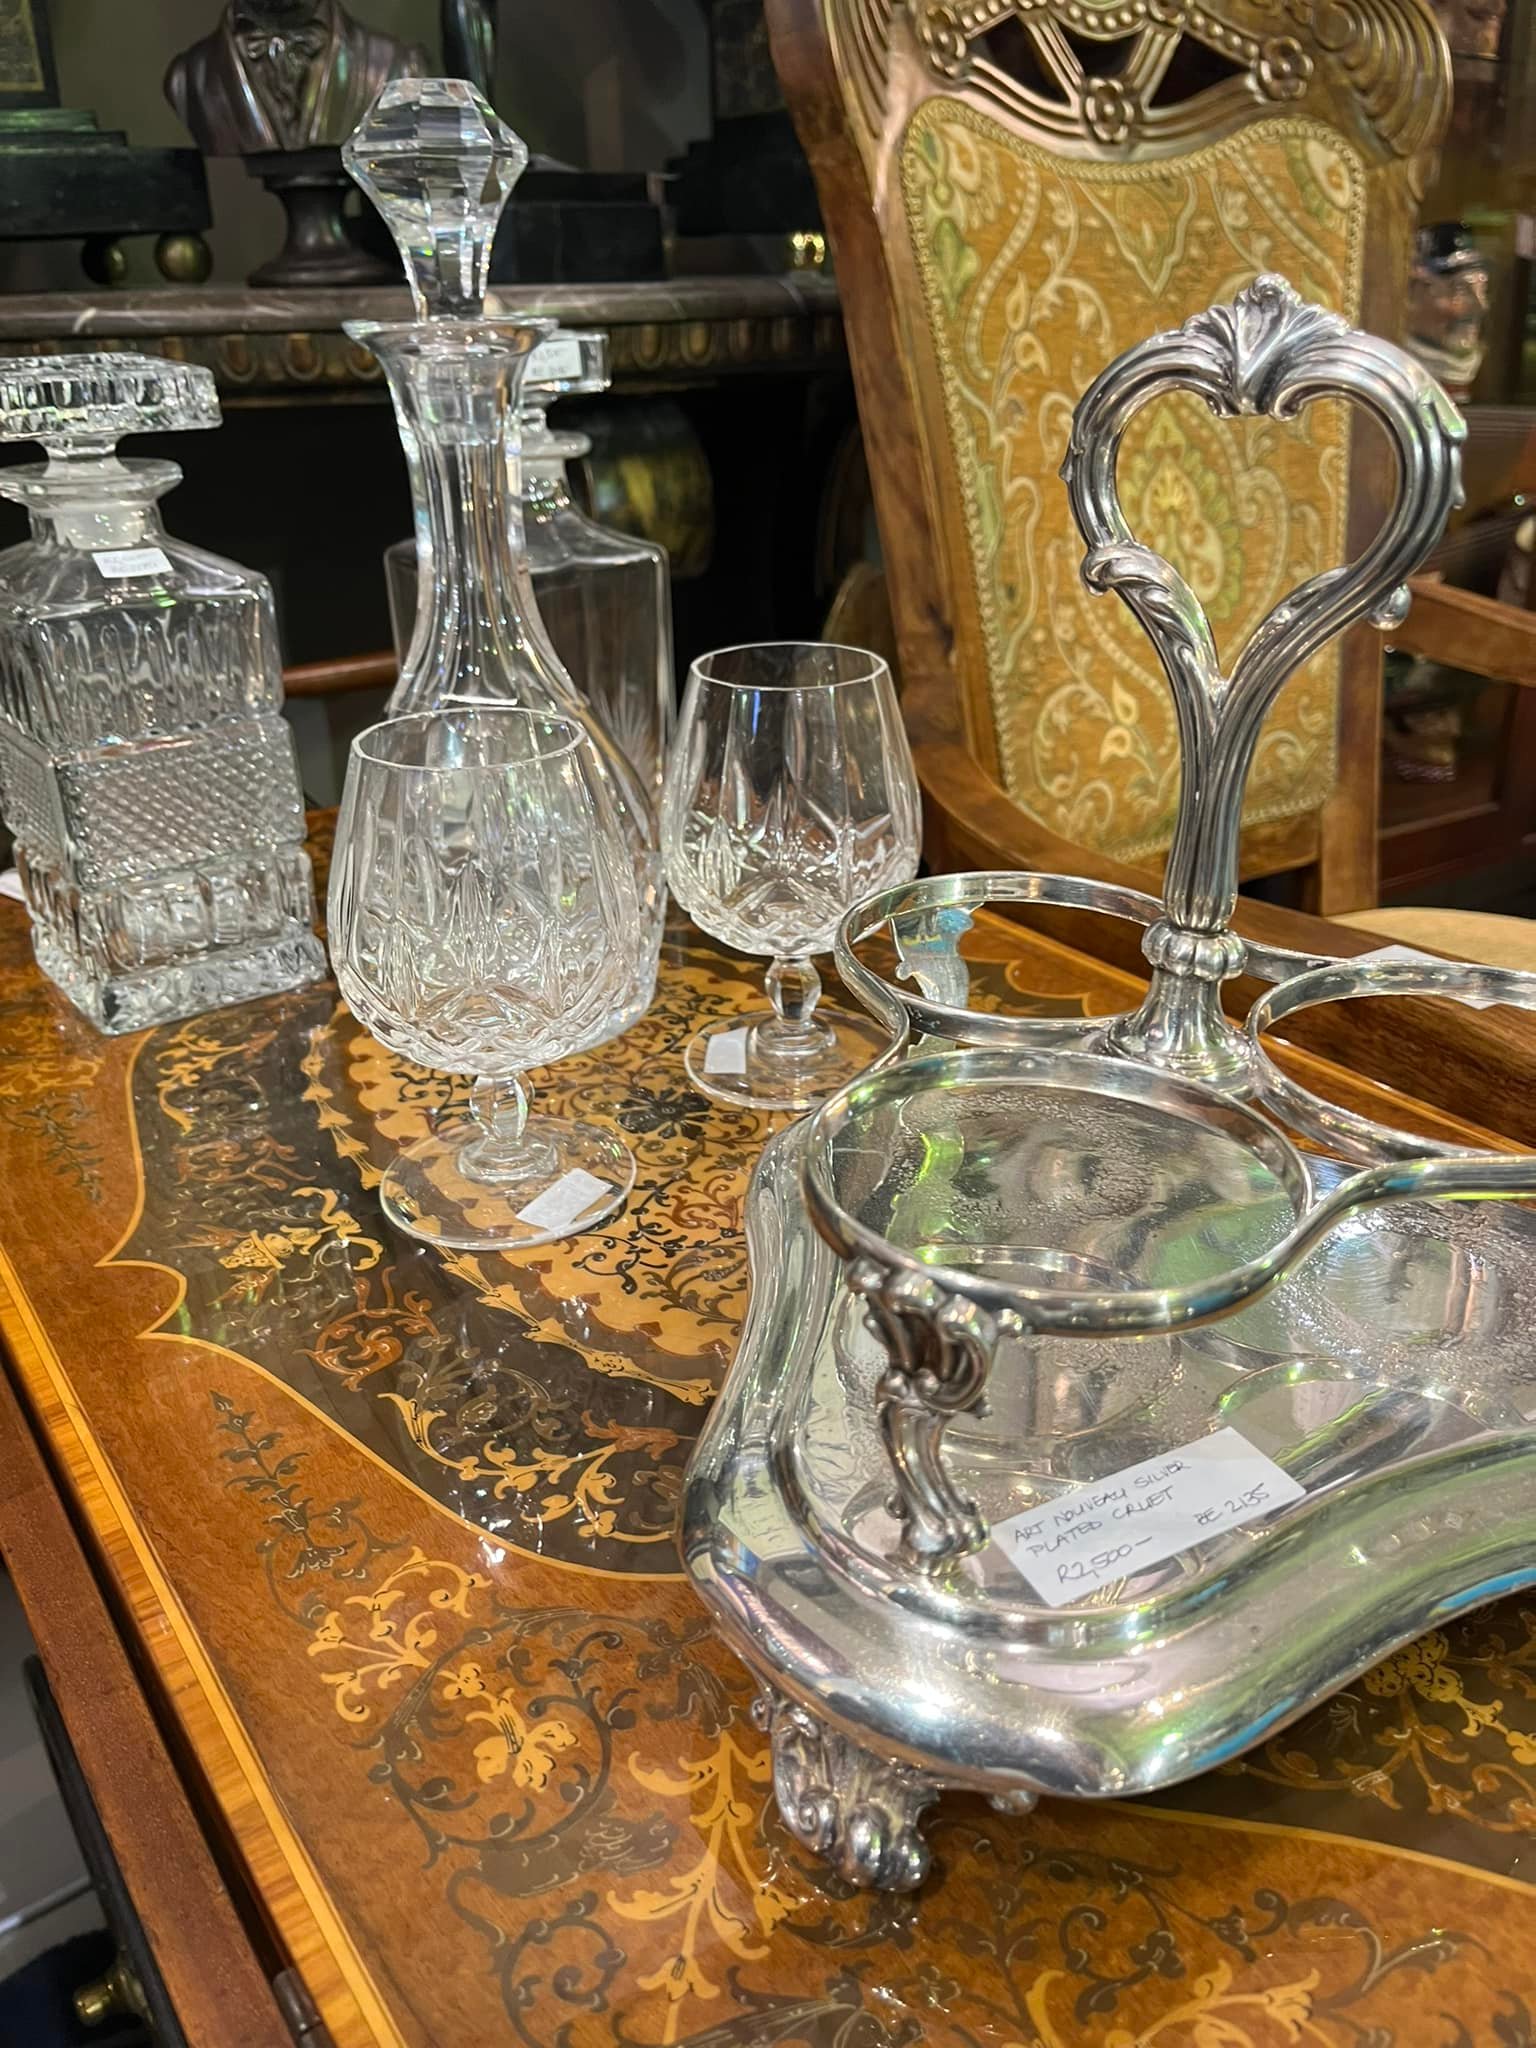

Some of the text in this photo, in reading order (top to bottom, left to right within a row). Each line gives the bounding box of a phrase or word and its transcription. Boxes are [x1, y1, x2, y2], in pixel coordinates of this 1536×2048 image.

[1014, 1459, 1192, 1543] ART NOUVEAU SILVER
[1025, 1485, 1174, 1558] PLATED CRUET
